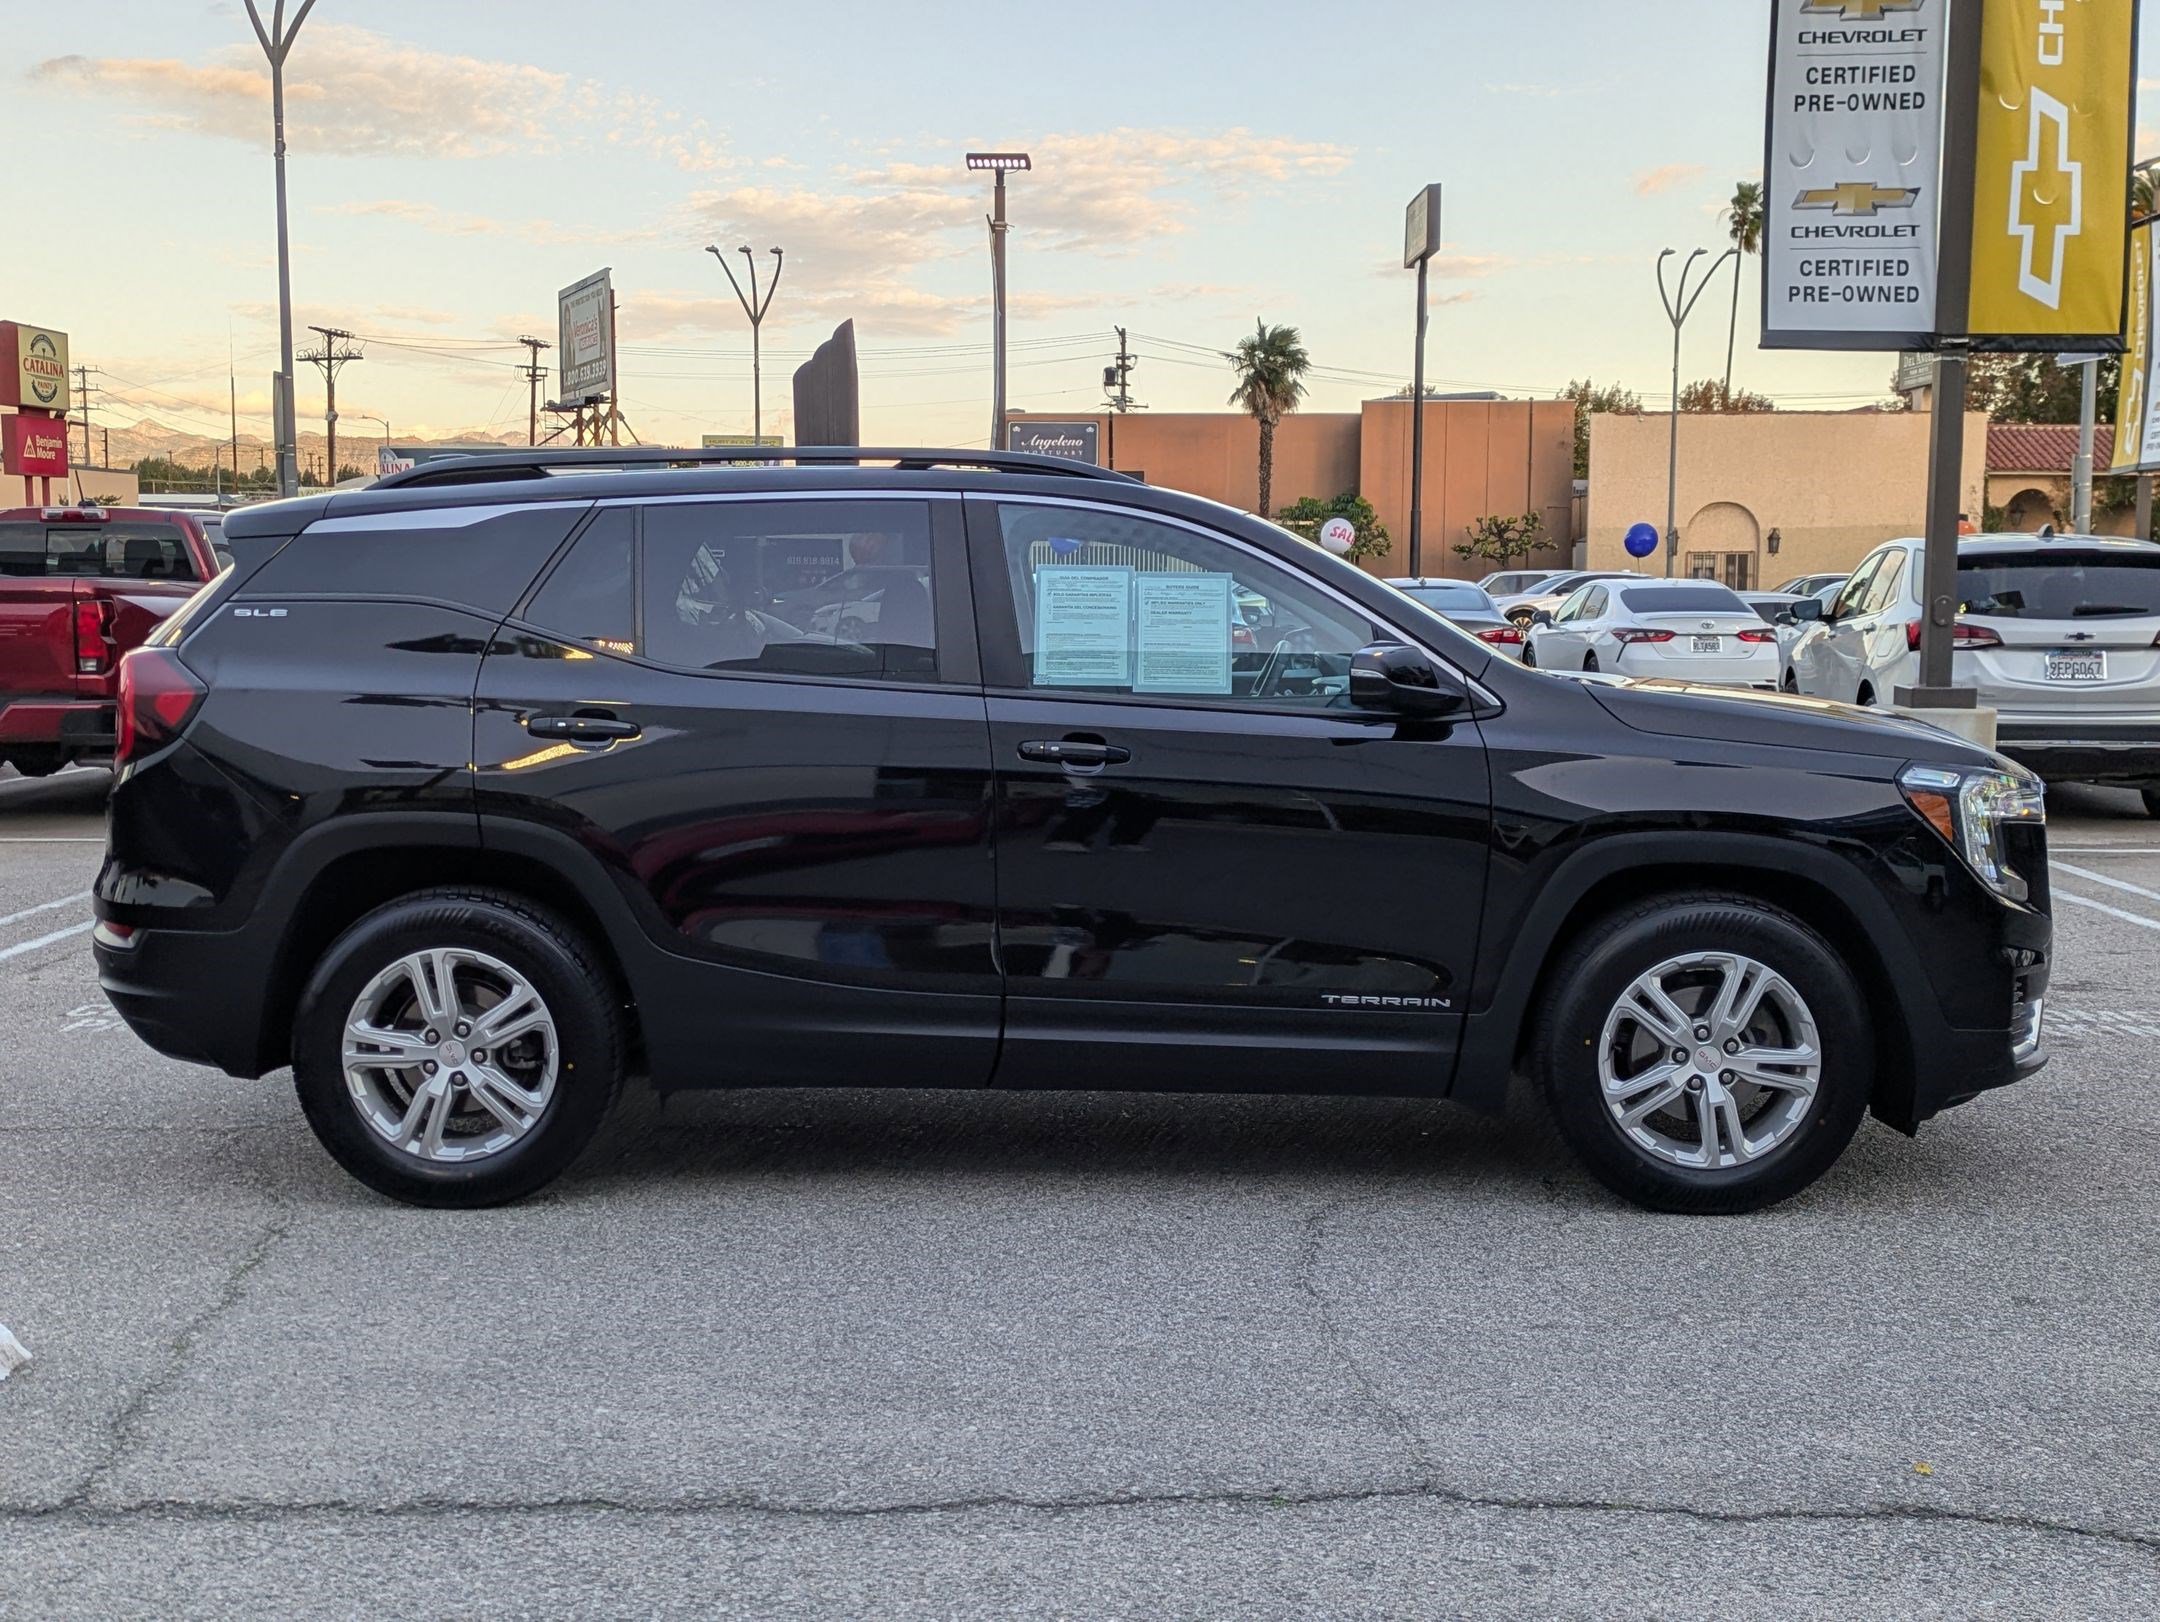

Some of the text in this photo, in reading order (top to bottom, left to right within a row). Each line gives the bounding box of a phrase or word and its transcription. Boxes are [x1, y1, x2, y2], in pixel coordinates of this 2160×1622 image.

[1798, 28, 1928, 45] CHEVROLET
[1805, 64, 1916, 85] CERTIFIED
[1793, 91, 1925, 112] PRE-OWNED
[1790, 224, 1921, 239] CHEVROLET
[1799, 259, 1910, 277] CERTIFIED
[1788, 285, 1920, 303] PRE-OWNED
[23, 357, 65, 378] CATALINA
[36, 434, 63, 450] Benjamin
[1021, 433, 1083, 450] Angeleno
[36, 448, 56, 460] Moore
[234, 608, 289, 617] SLE
[2050, 662, 2102, 675] 9EPG067
[1320, 994, 1451, 1008] TERRAIN
[1698, 1051, 1717, 1069] GMC
